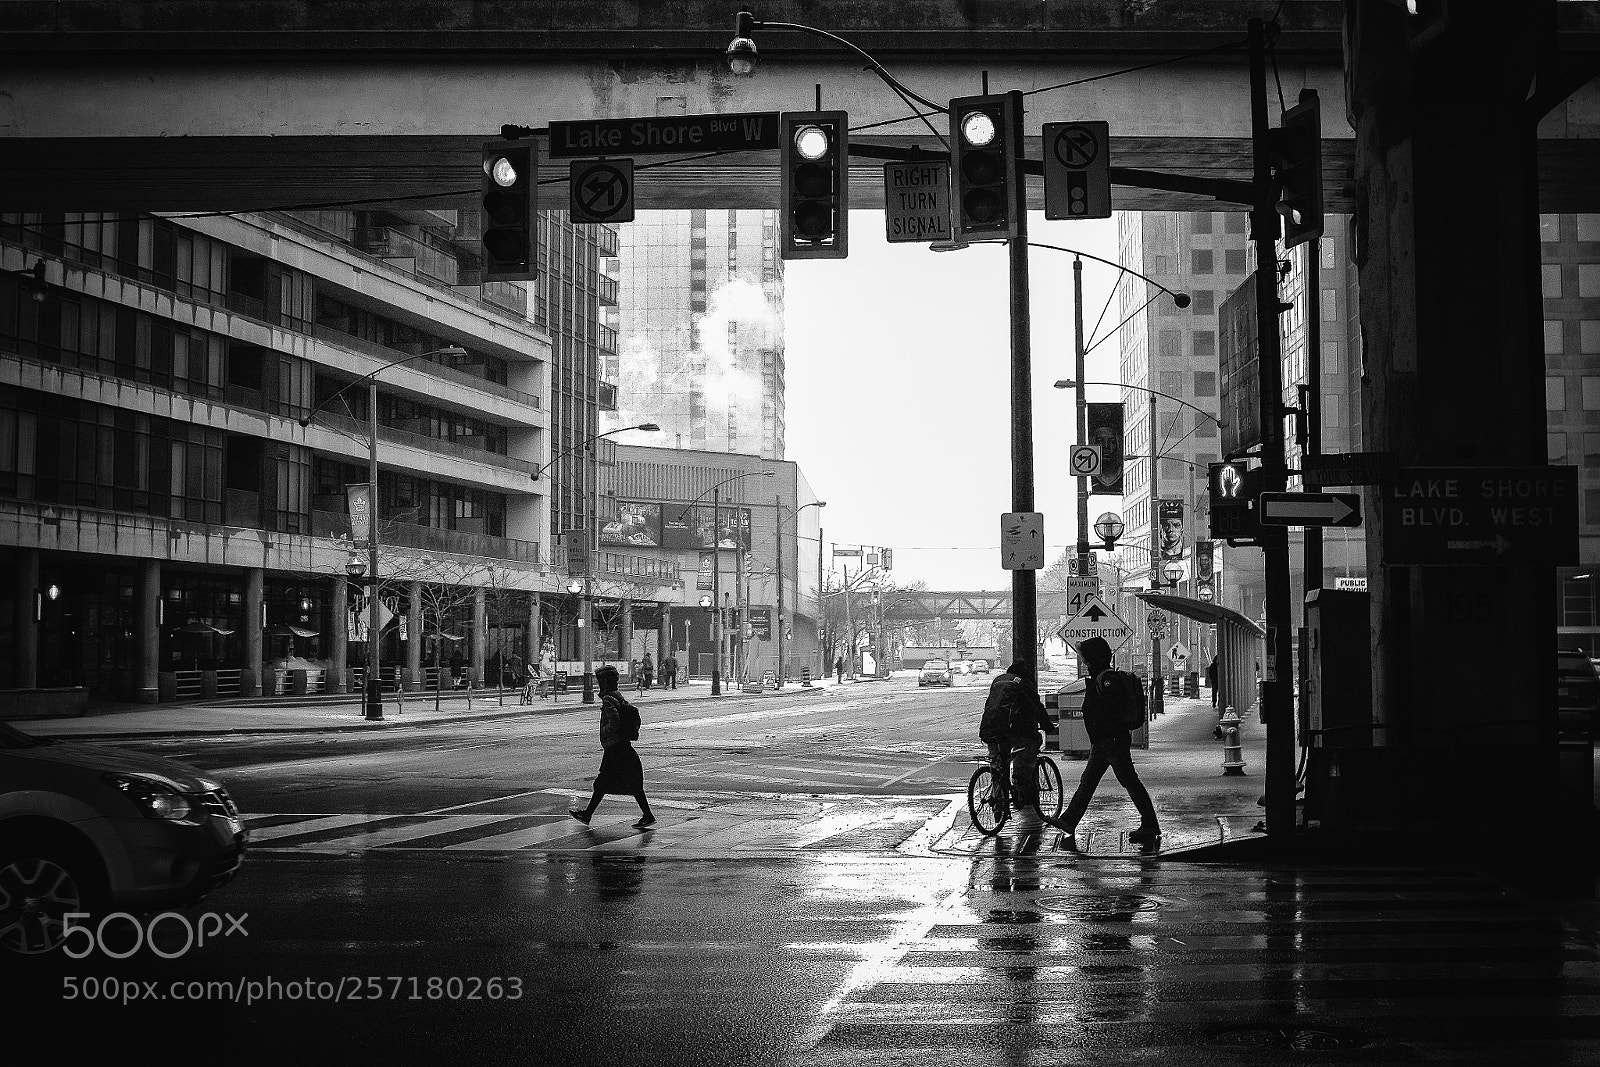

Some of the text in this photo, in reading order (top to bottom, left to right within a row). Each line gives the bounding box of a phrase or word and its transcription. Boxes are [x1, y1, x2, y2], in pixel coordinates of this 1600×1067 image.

[565, 117, 764, 148] Lake Shore Blvd W
[893, 168, 940, 186] RIGHT
[900, 192, 937, 210] TURN
[893, 216, 945, 234] SIGNAL
[1394, 479, 1566, 498] LAKE SHORE
[1402, 507, 1556, 526] BLVD. WEST
[1069, 580, 1096, 588] MAXIMUM
[1340, 579, 1366, 587] PUBLIC
[1064, 628, 1126, 638] CONSTRUCTION
